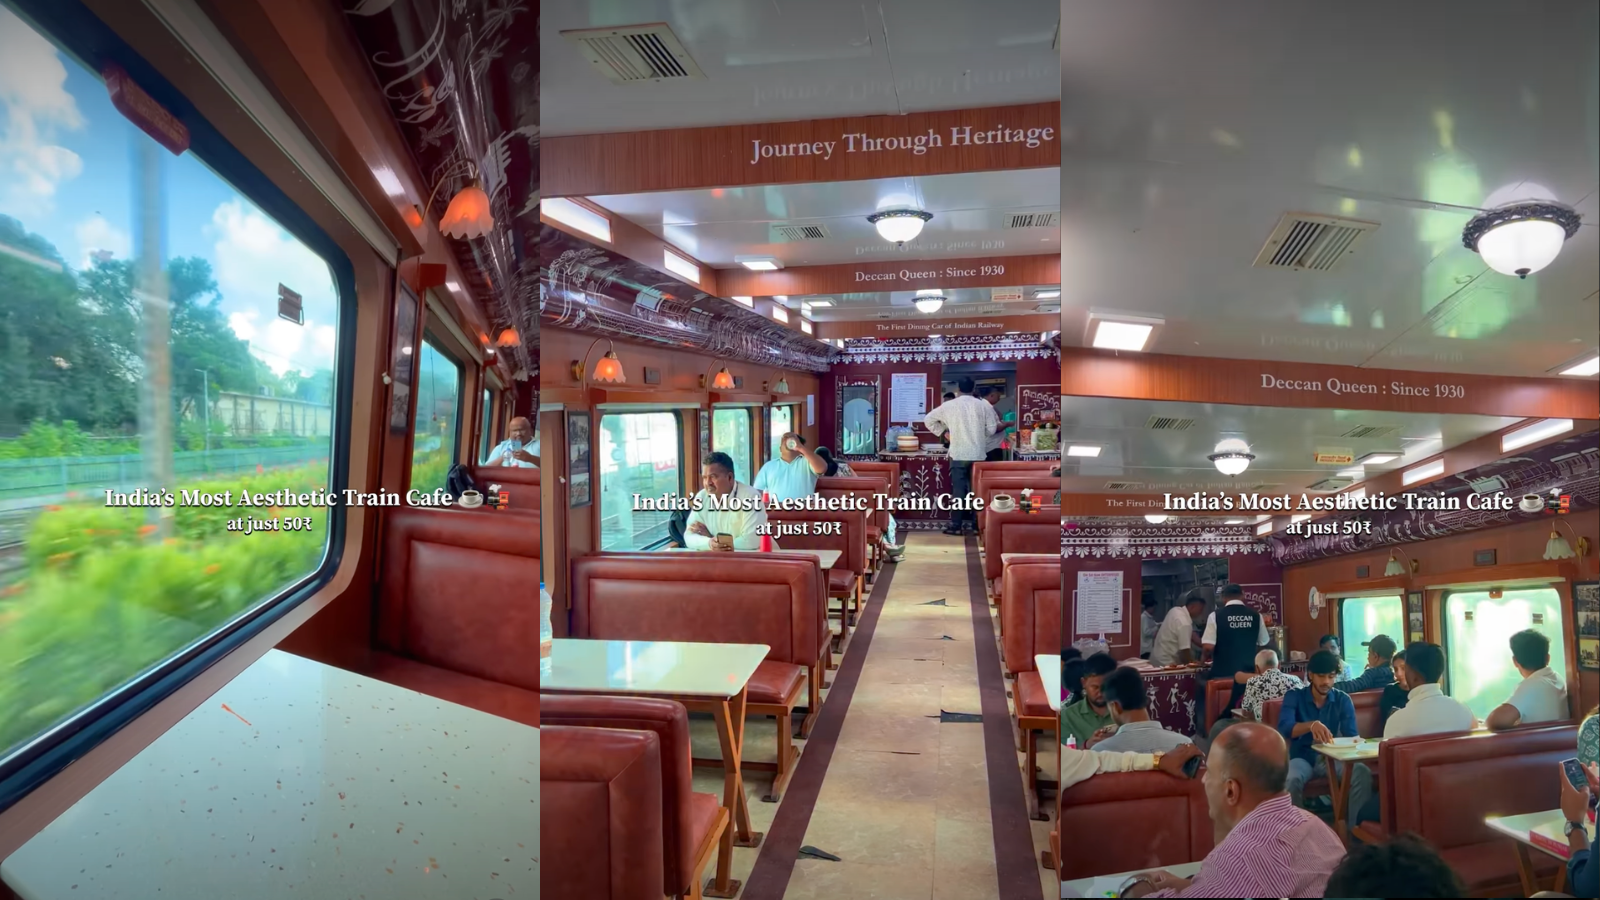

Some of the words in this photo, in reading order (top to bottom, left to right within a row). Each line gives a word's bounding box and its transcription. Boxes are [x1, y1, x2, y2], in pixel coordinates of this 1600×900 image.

[750, 139, 837, 164] Journey
[842, 129, 943, 155] Through
[950, 124, 1055, 148] Heritage
[855, 271, 896, 282] Deccan
[899, 269, 936, 281] Queen
[946, 267, 977, 277] Since
[980, 265, 1005, 276] 1930
[907, 323, 930, 331] Dining
[931, 322, 943, 330] Car
[977, 321, 1004, 329] Railway
[1260, 373, 1322, 392] Deccan
[1326, 377, 1377, 395] Queen
[1391, 381, 1430, 397] Since
[1434, 384, 1465, 399] 1930
[1106, 499, 1124, 507] The
[1126, 499, 1146, 508] First
